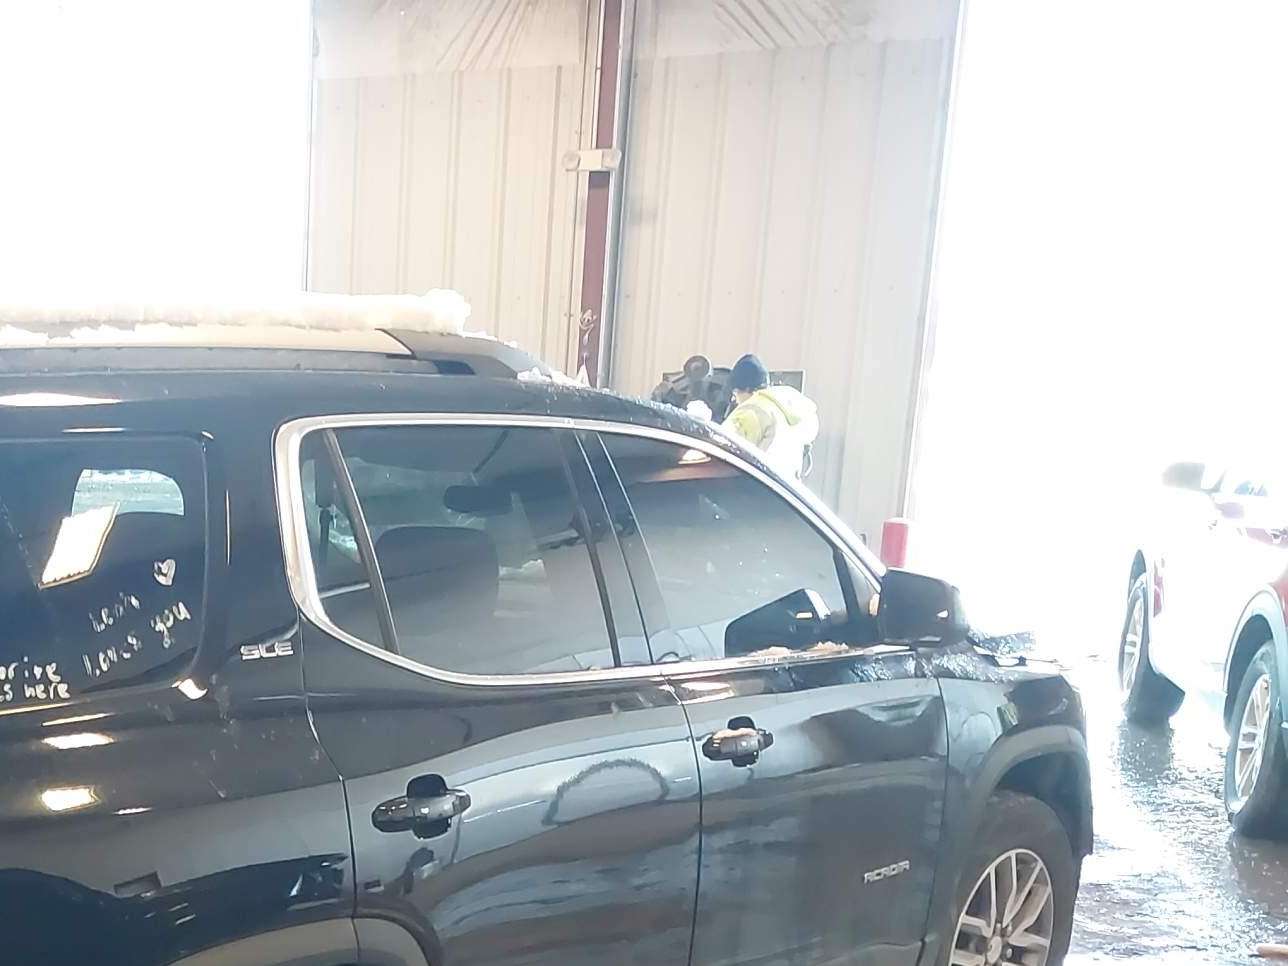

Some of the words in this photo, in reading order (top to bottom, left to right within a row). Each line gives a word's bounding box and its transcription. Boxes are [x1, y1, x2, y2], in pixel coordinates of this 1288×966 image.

[150, 601, 192, 649] you
[240, 641, 294, 661] SLE
[23, 682, 72, 701] here
